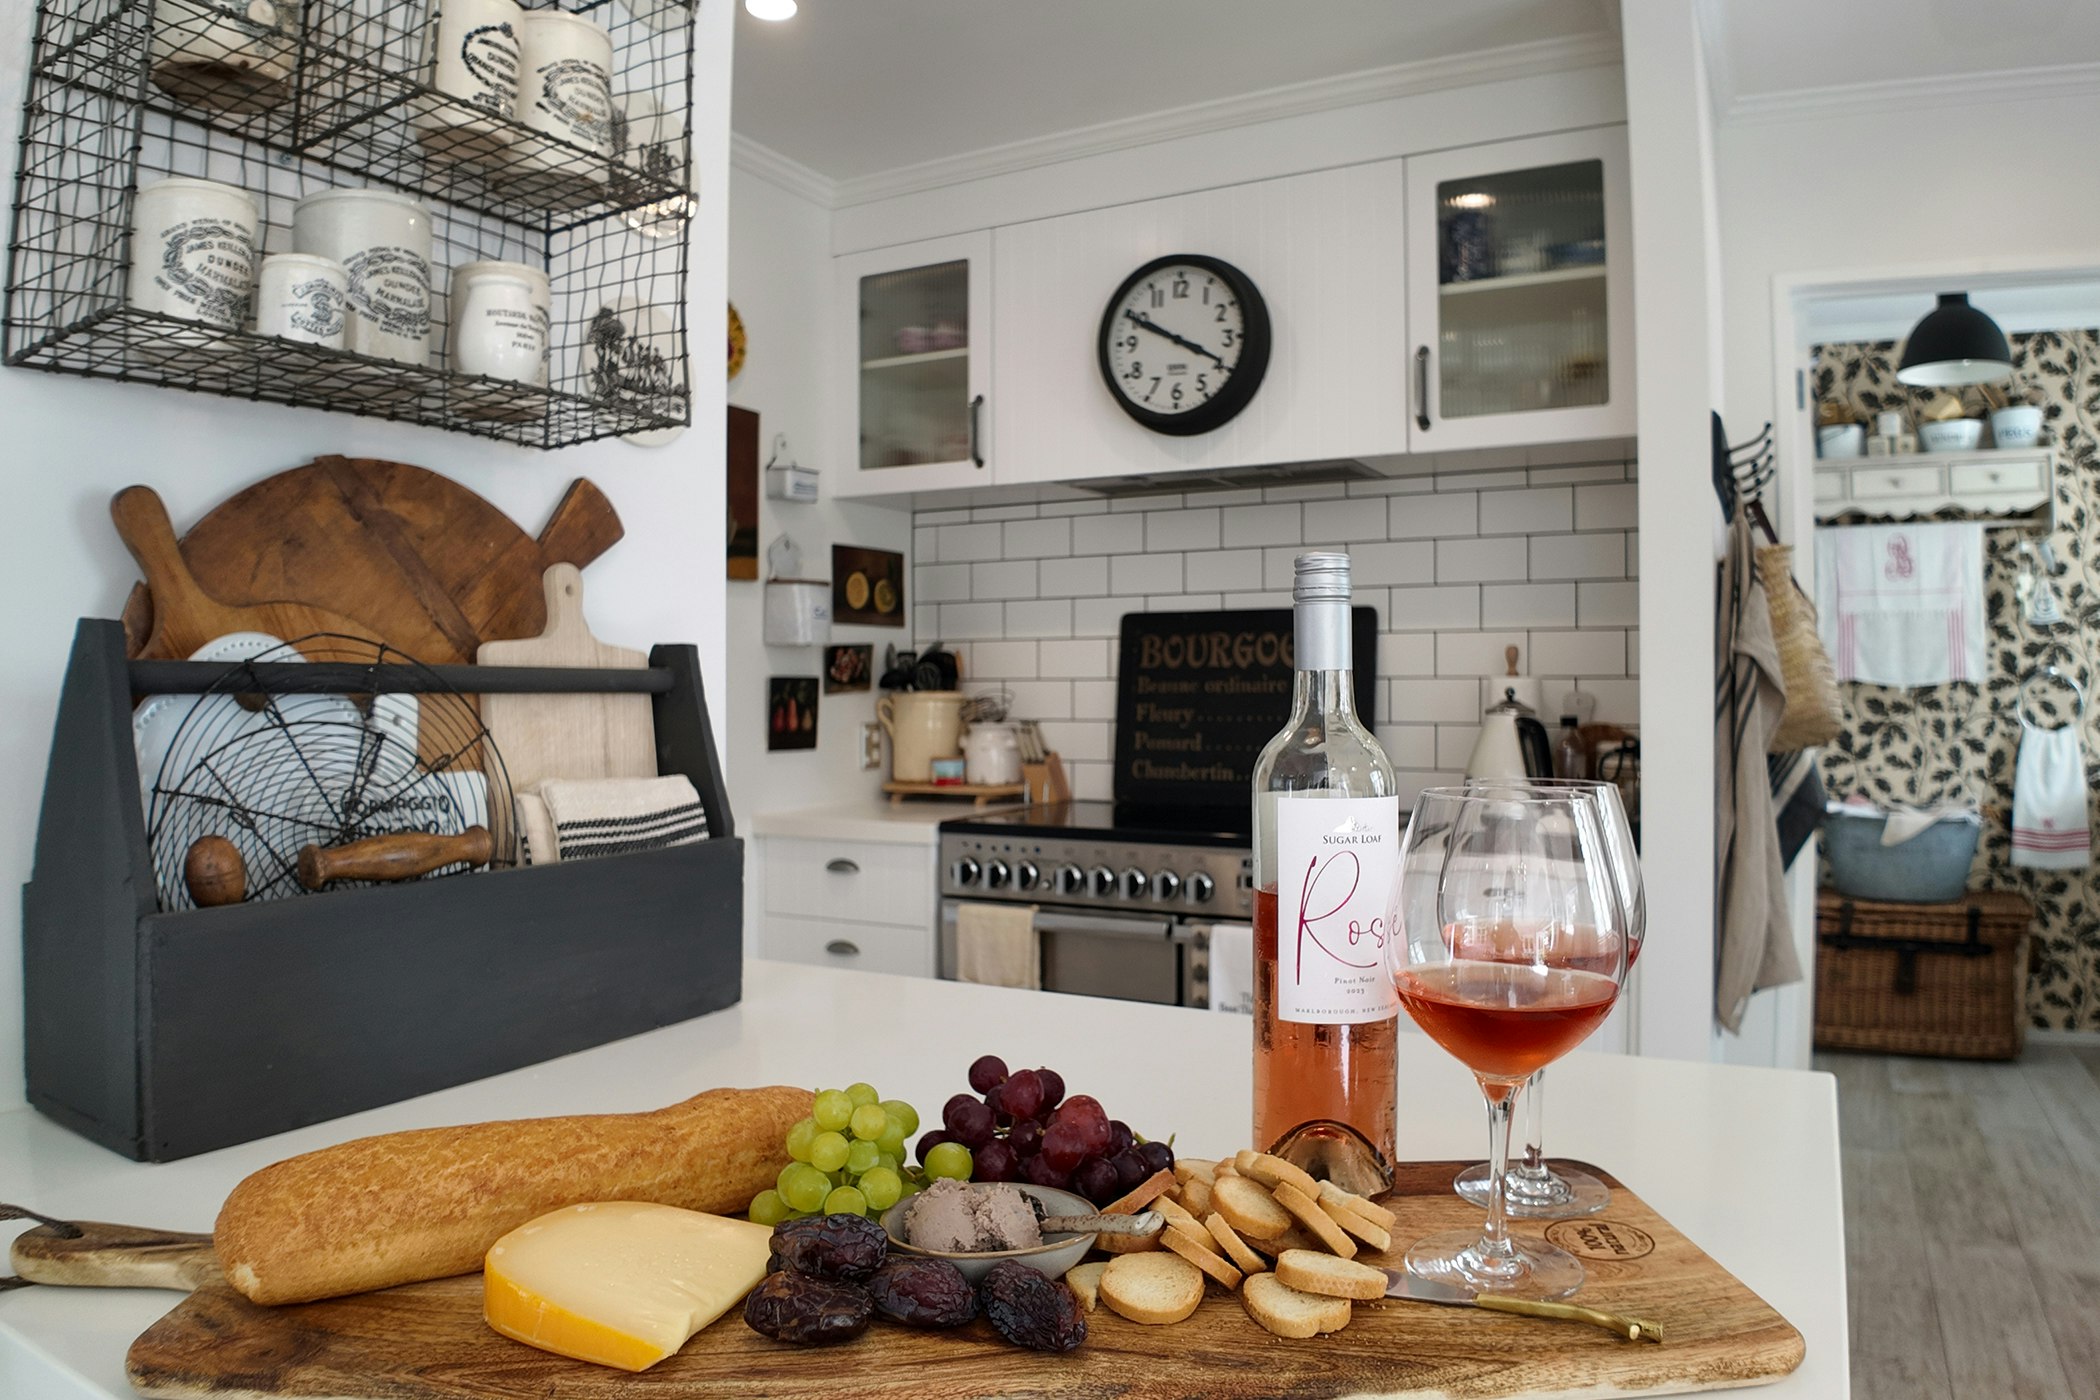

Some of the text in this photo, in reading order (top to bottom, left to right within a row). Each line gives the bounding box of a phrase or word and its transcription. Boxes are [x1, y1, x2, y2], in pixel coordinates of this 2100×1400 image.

[1151, 289, 1164, 309] 11
[1172, 280, 1190, 299] 12
[1203, 286, 1209, 305] 1
[1215, 303, 1227, 322] 2
[1126, 335, 1139, 353] 9
[1221, 329, 1234, 348] 3
[1130, 361, 1143, 380] 8
[1150, 376, 1162, 395] 7
[1171, 382, 1183, 401] 6
[1195, 373, 1207, 392] 5
[1204, 673, 1287, 694] ordinaire
[1322, 834, 1382, 845] SUGAR LOAF
[1333, 975, 1376, 985] Pinot Noir
